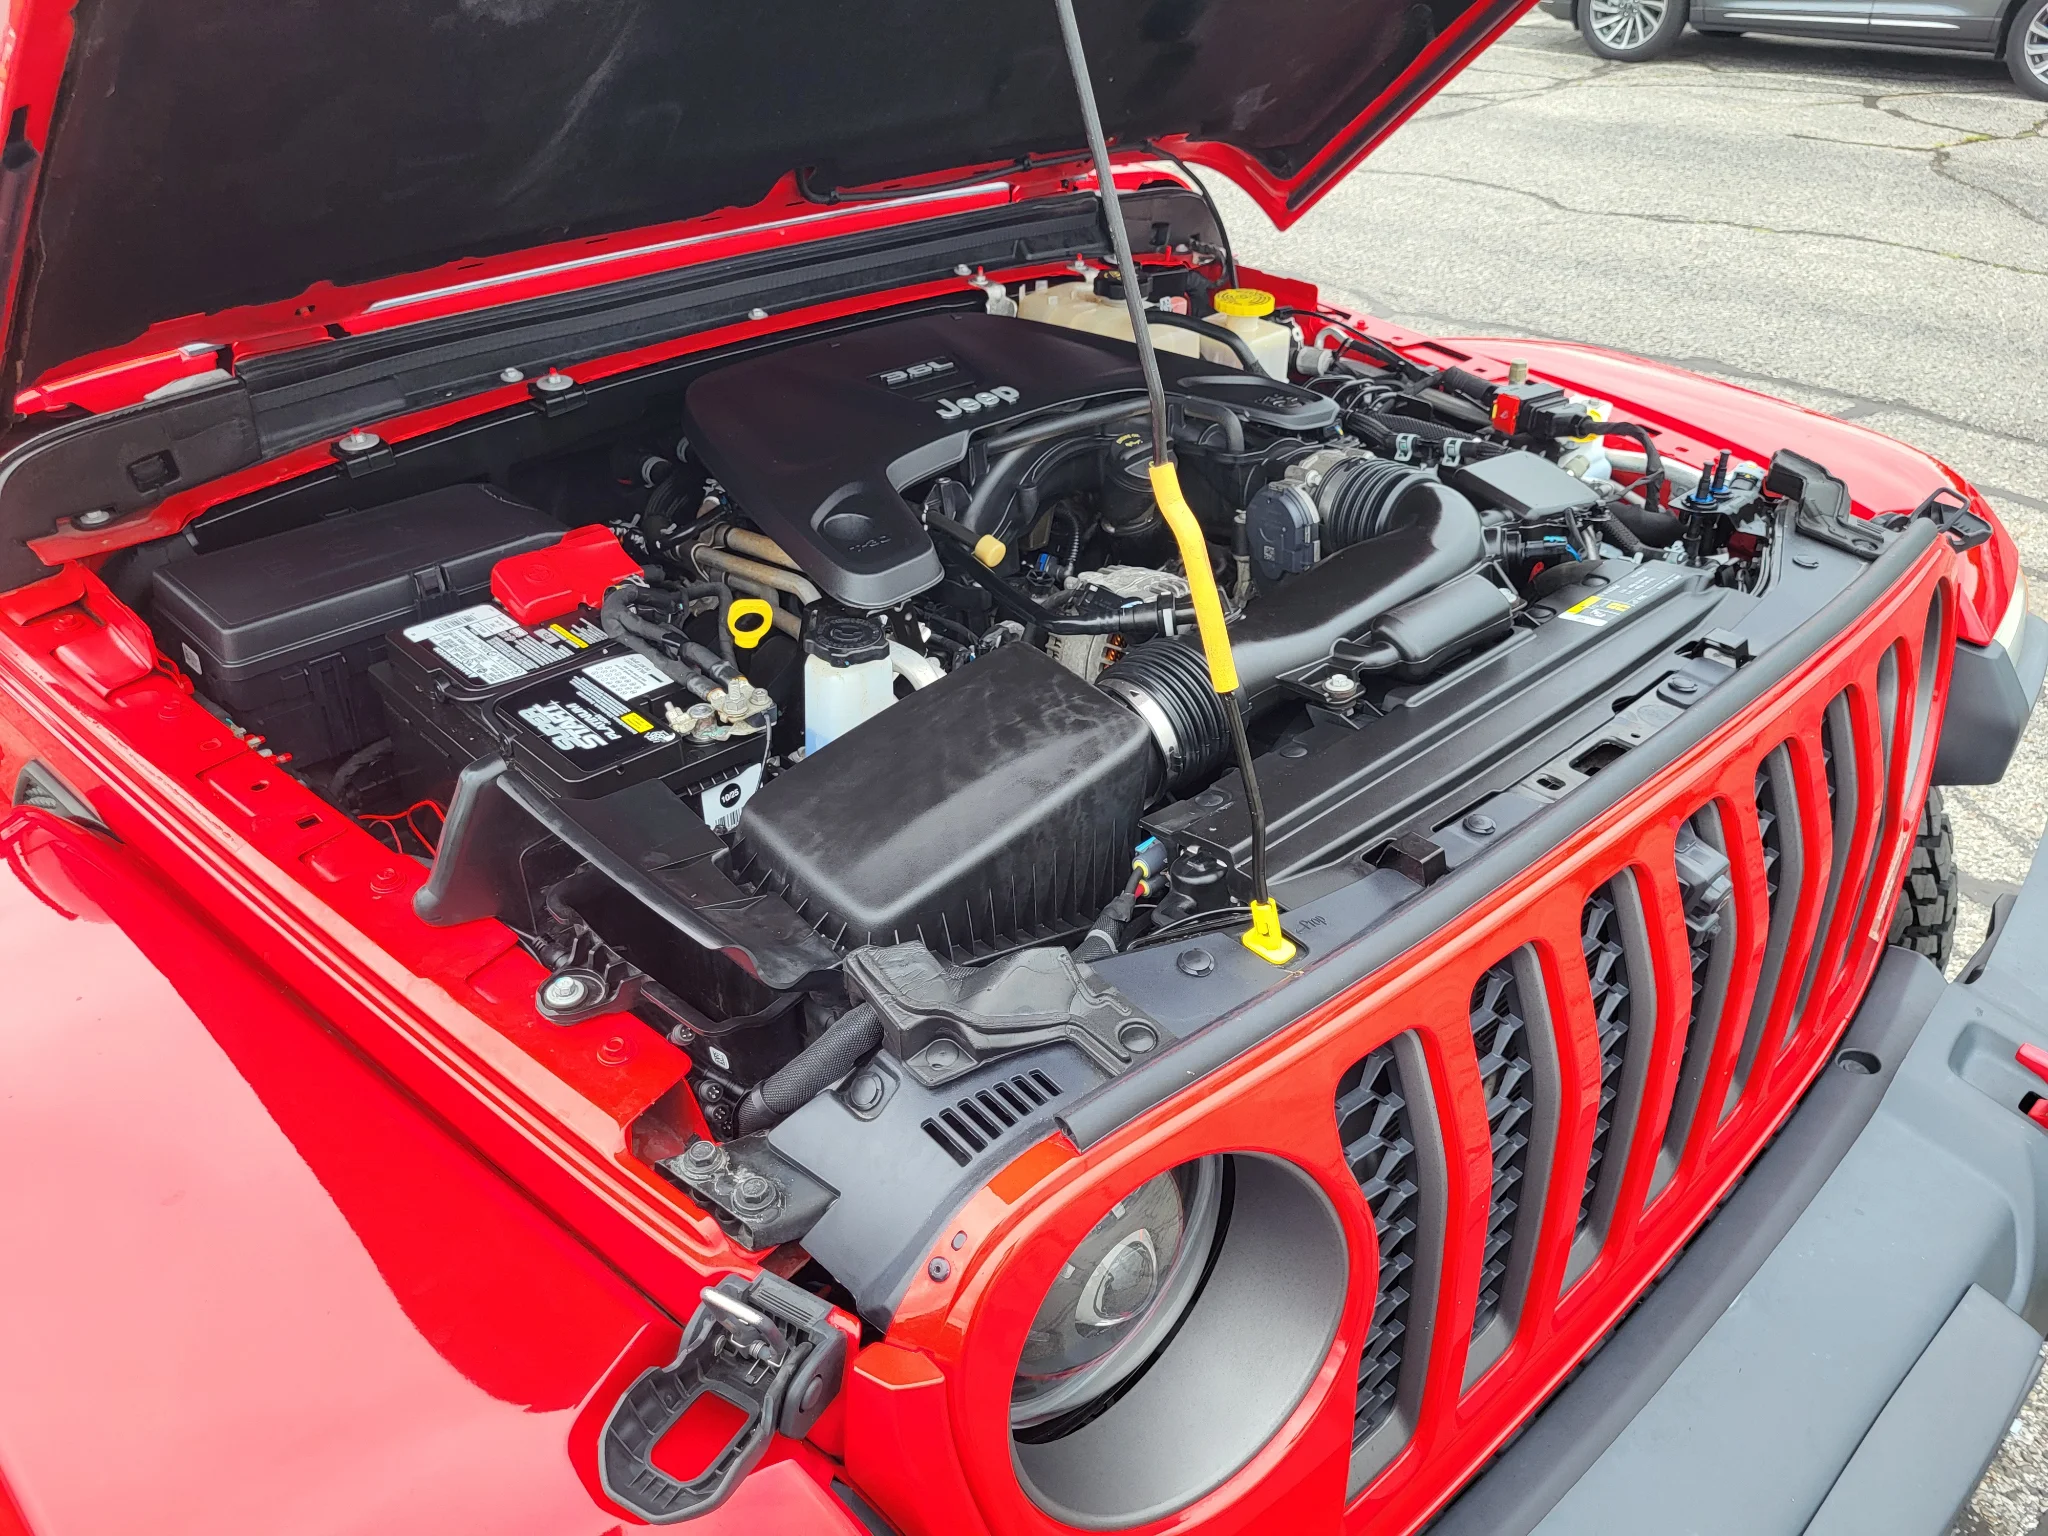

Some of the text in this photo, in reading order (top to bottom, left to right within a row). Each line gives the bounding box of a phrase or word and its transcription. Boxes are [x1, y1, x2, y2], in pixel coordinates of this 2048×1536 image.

[936, 385, 1020, 420] Jeep
[518, 707, 576, 751] SUPER
[532, 702, 609, 750] START
[565, 703, 622, 740] PLATINUM
[720, 788, 740, 803] 10/25
[1298, 915, 1327, 930] Prop
